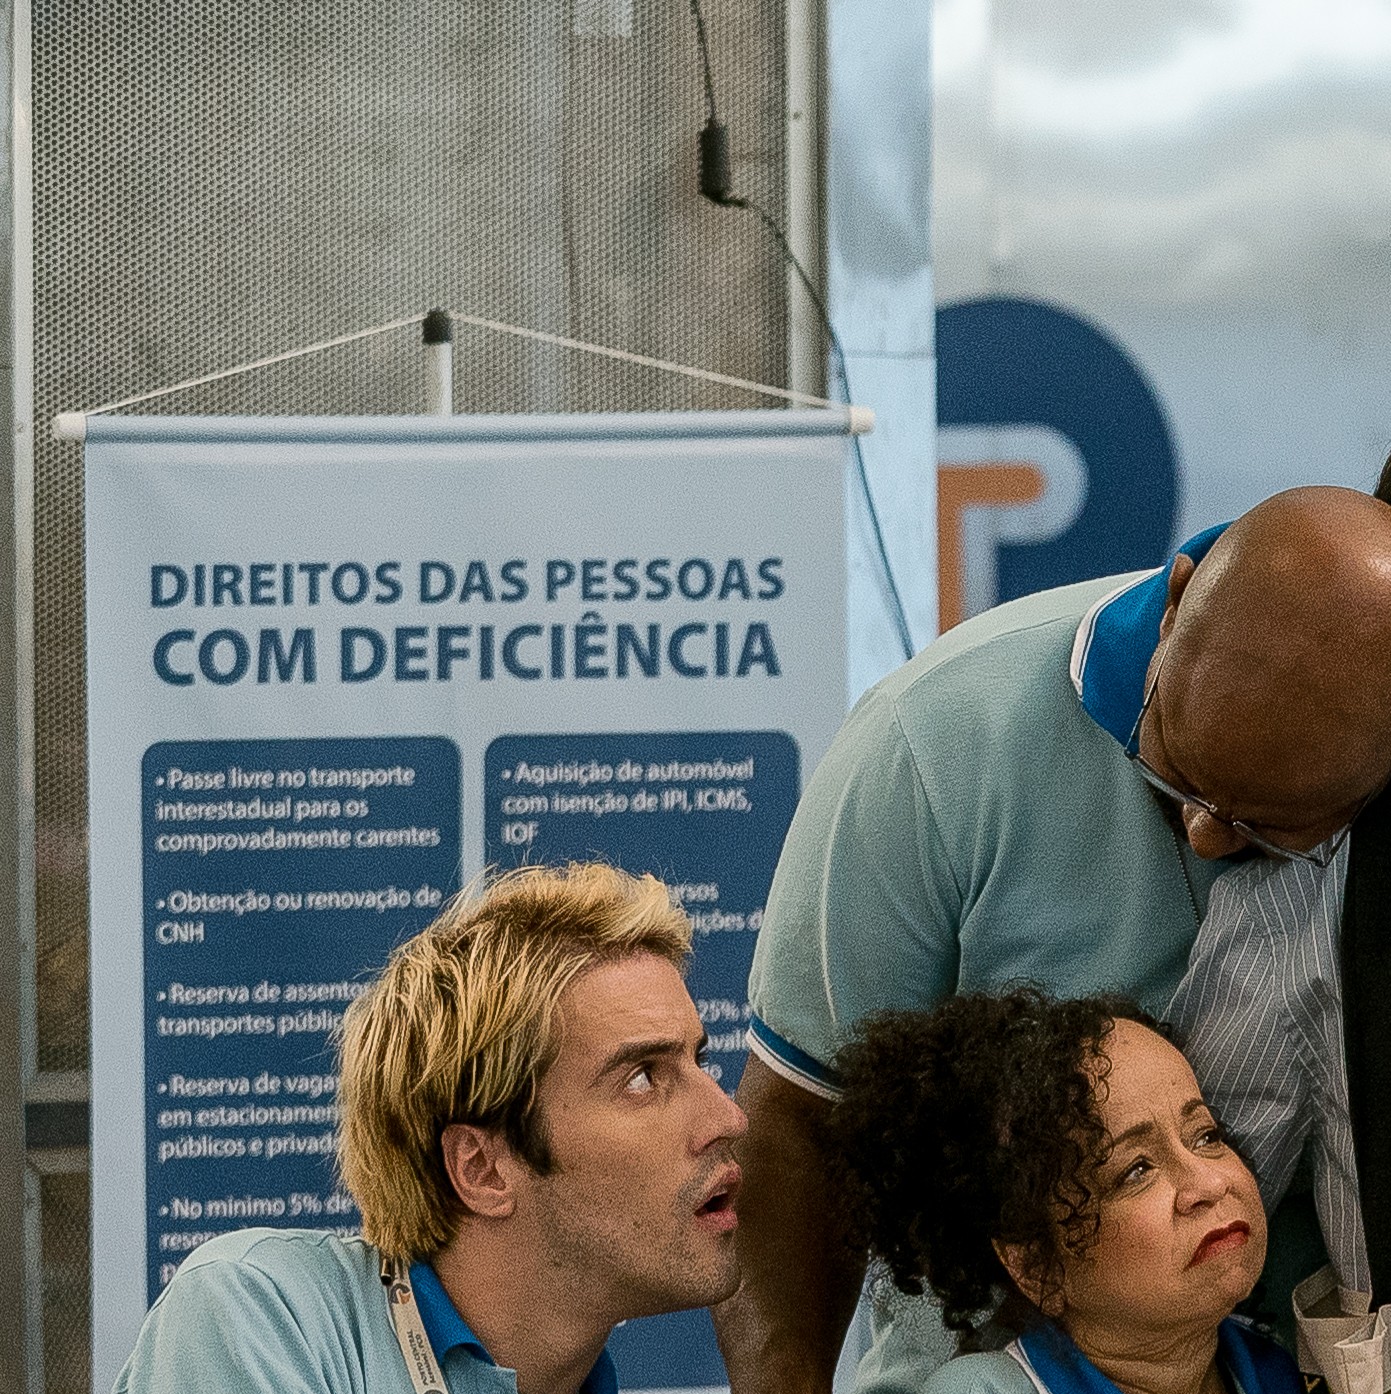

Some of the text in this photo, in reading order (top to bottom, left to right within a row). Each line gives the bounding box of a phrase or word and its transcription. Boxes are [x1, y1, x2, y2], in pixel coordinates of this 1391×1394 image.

[150, 555, 785, 608] DIREITOS DAS PESSOAS
[152, 611, 783, 686] COM DEFICIÊNCIA
[168, 765, 415, 791] Passe livre no transporte
[514, 756, 754, 787] Aquisição de automóvel
[157, 796, 369, 823] interestadual para os
[501, 788, 752, 817] com isenção de IPI, ICMS,
[156, 826, 441, 856] comprovadamente carentes
[501, 822, 538, 846] IOF
[168, 885, 442, 916] Obtenção ou renovação de
[156, 921, 205, 946] CNH
[170, 982, 249, 1006] Reserva
[254, 979, 281, 1004] de
[157, 1013, 275, 1040] transportes
[171, 1074, 250, 1098] Reserva
[254, 1071, 282, 1096] de
[159, 1109, 192, 1128] em
[158, 1134, 246, 1163] públicos
[250, 1140, 265, 1157] e
[172, 1198, 202, 1220] No
[290, 1192, 322, 1217] 5%
[406, 1330, 429, 1386] POSTO CENTRAL
